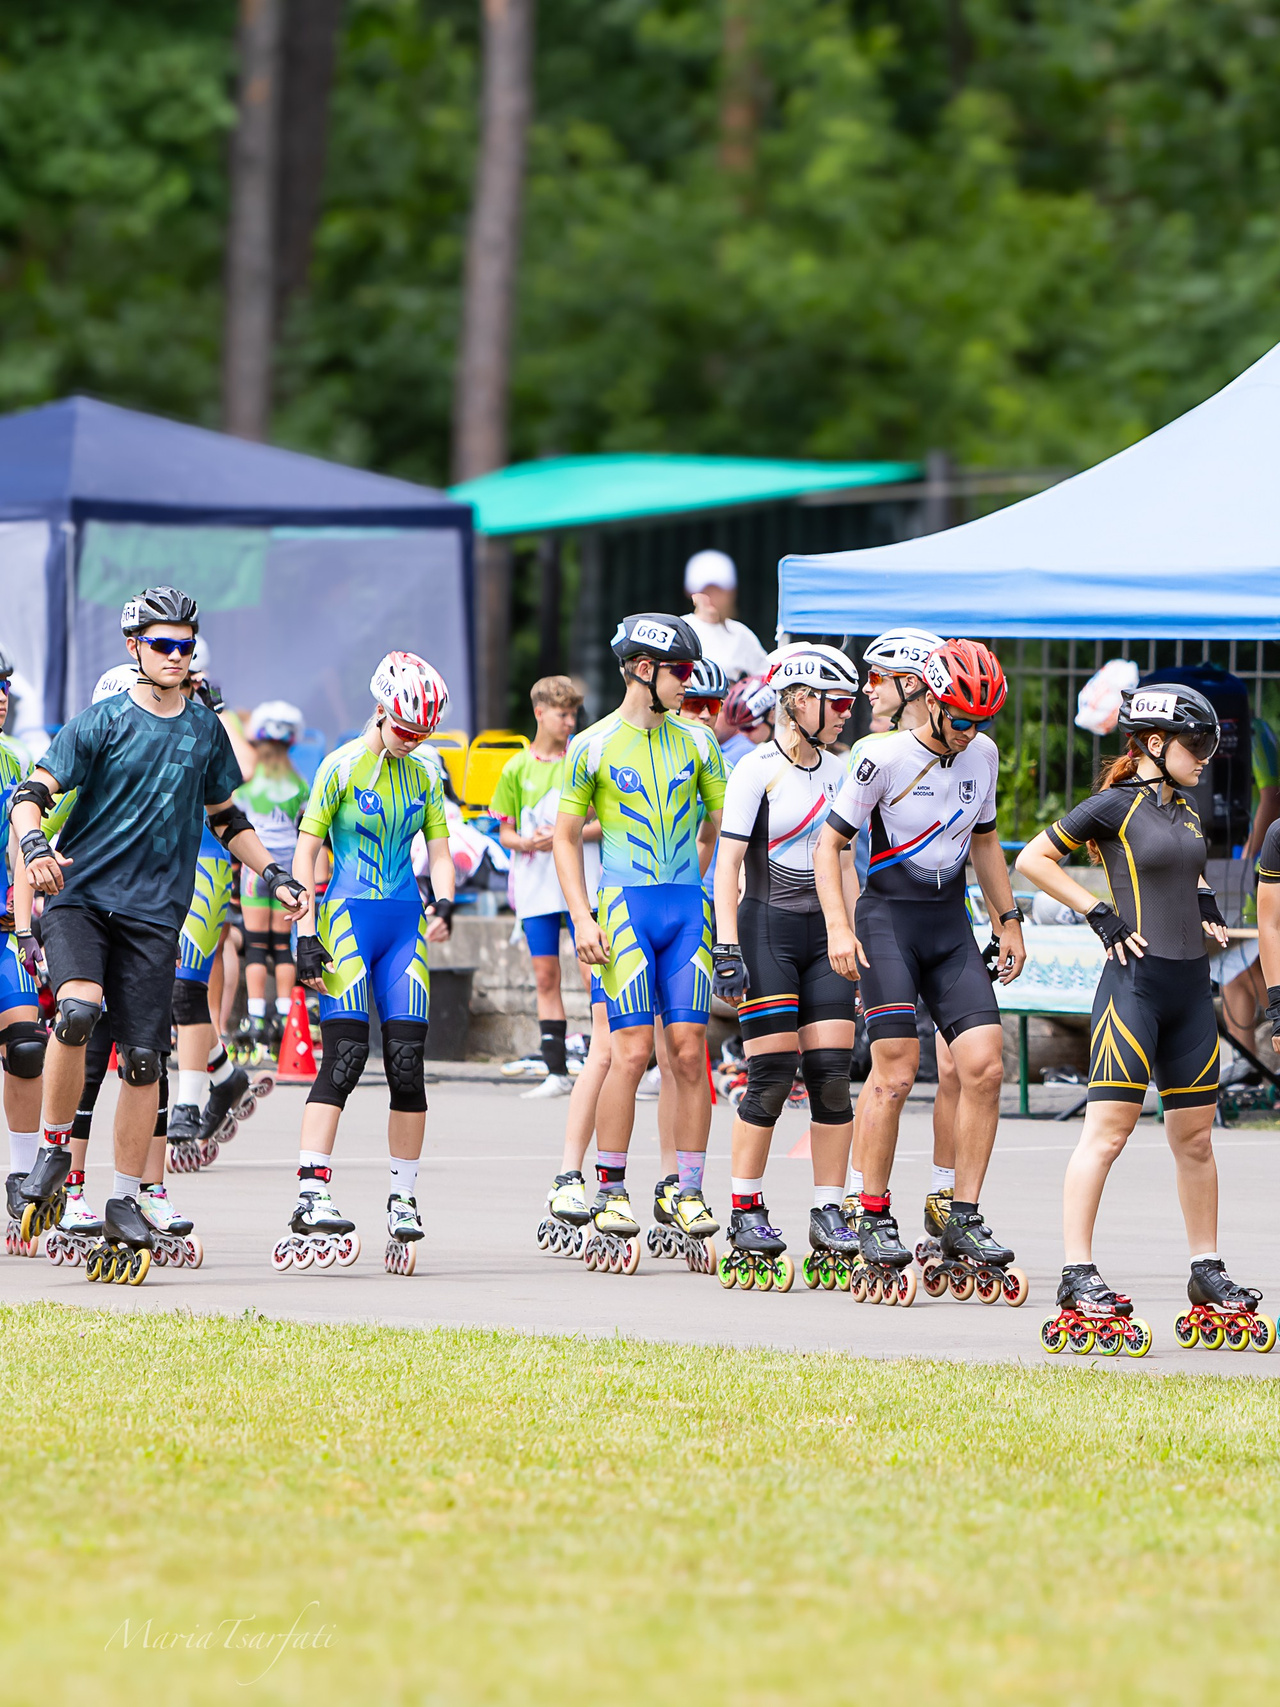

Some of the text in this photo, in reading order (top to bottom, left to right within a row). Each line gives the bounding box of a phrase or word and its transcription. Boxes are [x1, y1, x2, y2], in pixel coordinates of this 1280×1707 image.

[637, 625, 668, 644] 663
[900, 646, 931, 663] 652
[784, 661, 815, 677] 610
[376, 673, 395, 697] 608
[1135, 698, 1168, 713] 601
